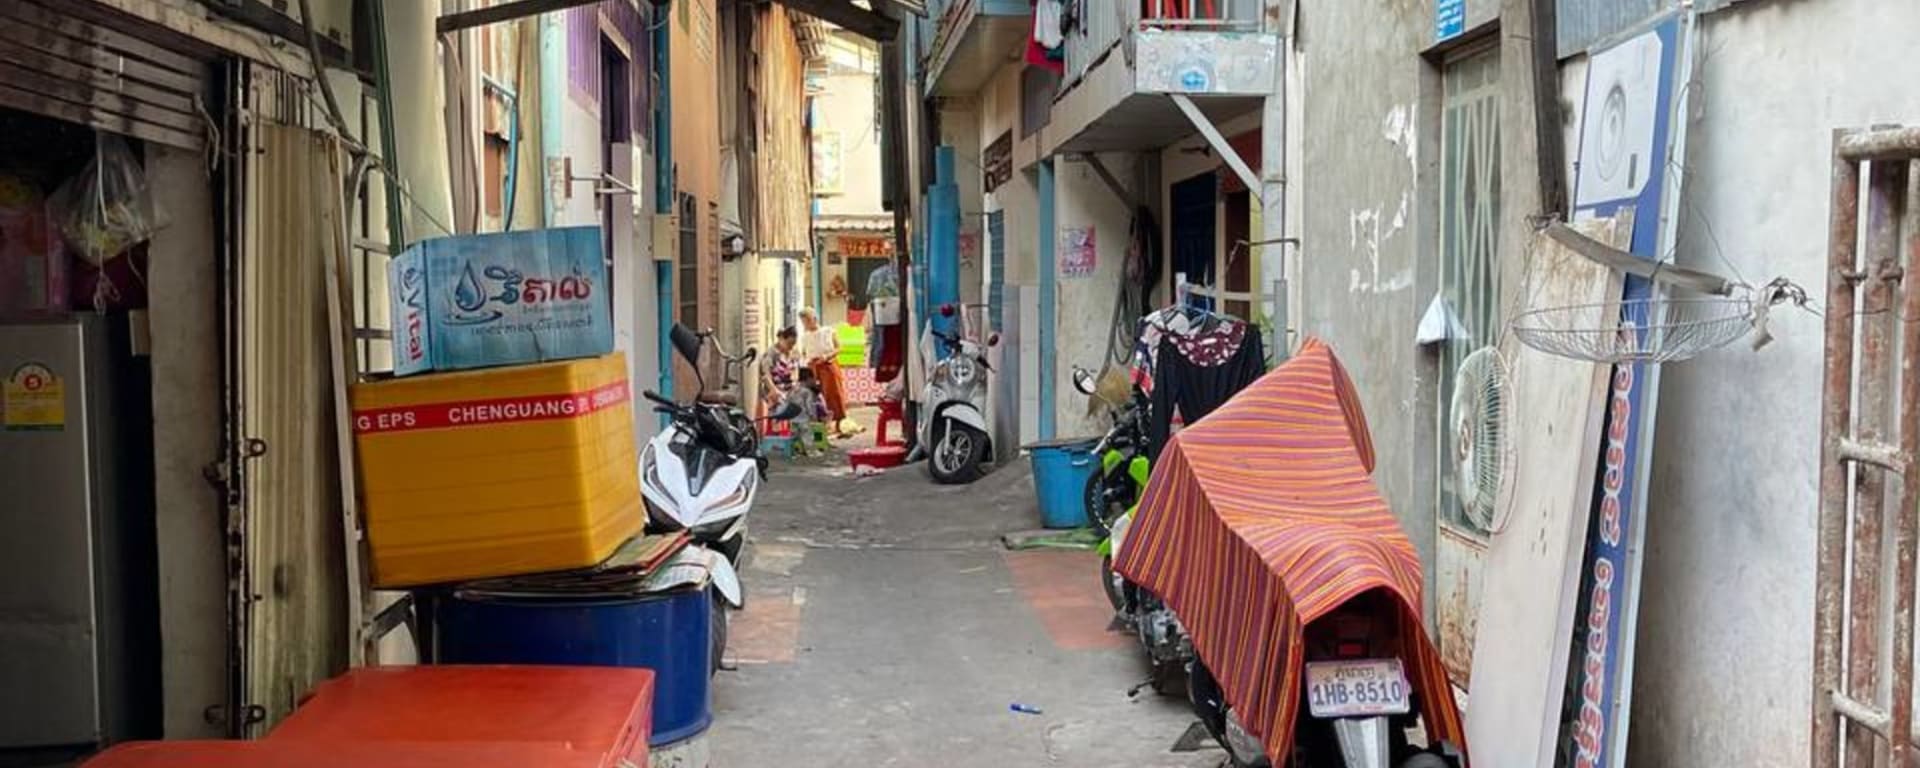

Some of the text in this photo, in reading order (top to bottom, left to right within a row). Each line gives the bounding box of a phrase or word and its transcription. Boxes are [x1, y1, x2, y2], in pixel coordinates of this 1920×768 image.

[407, 288, 424, 361] Vital
[378, 411, 417, 429] EPS
[448, 400, 575, 423] CHENGUANG
